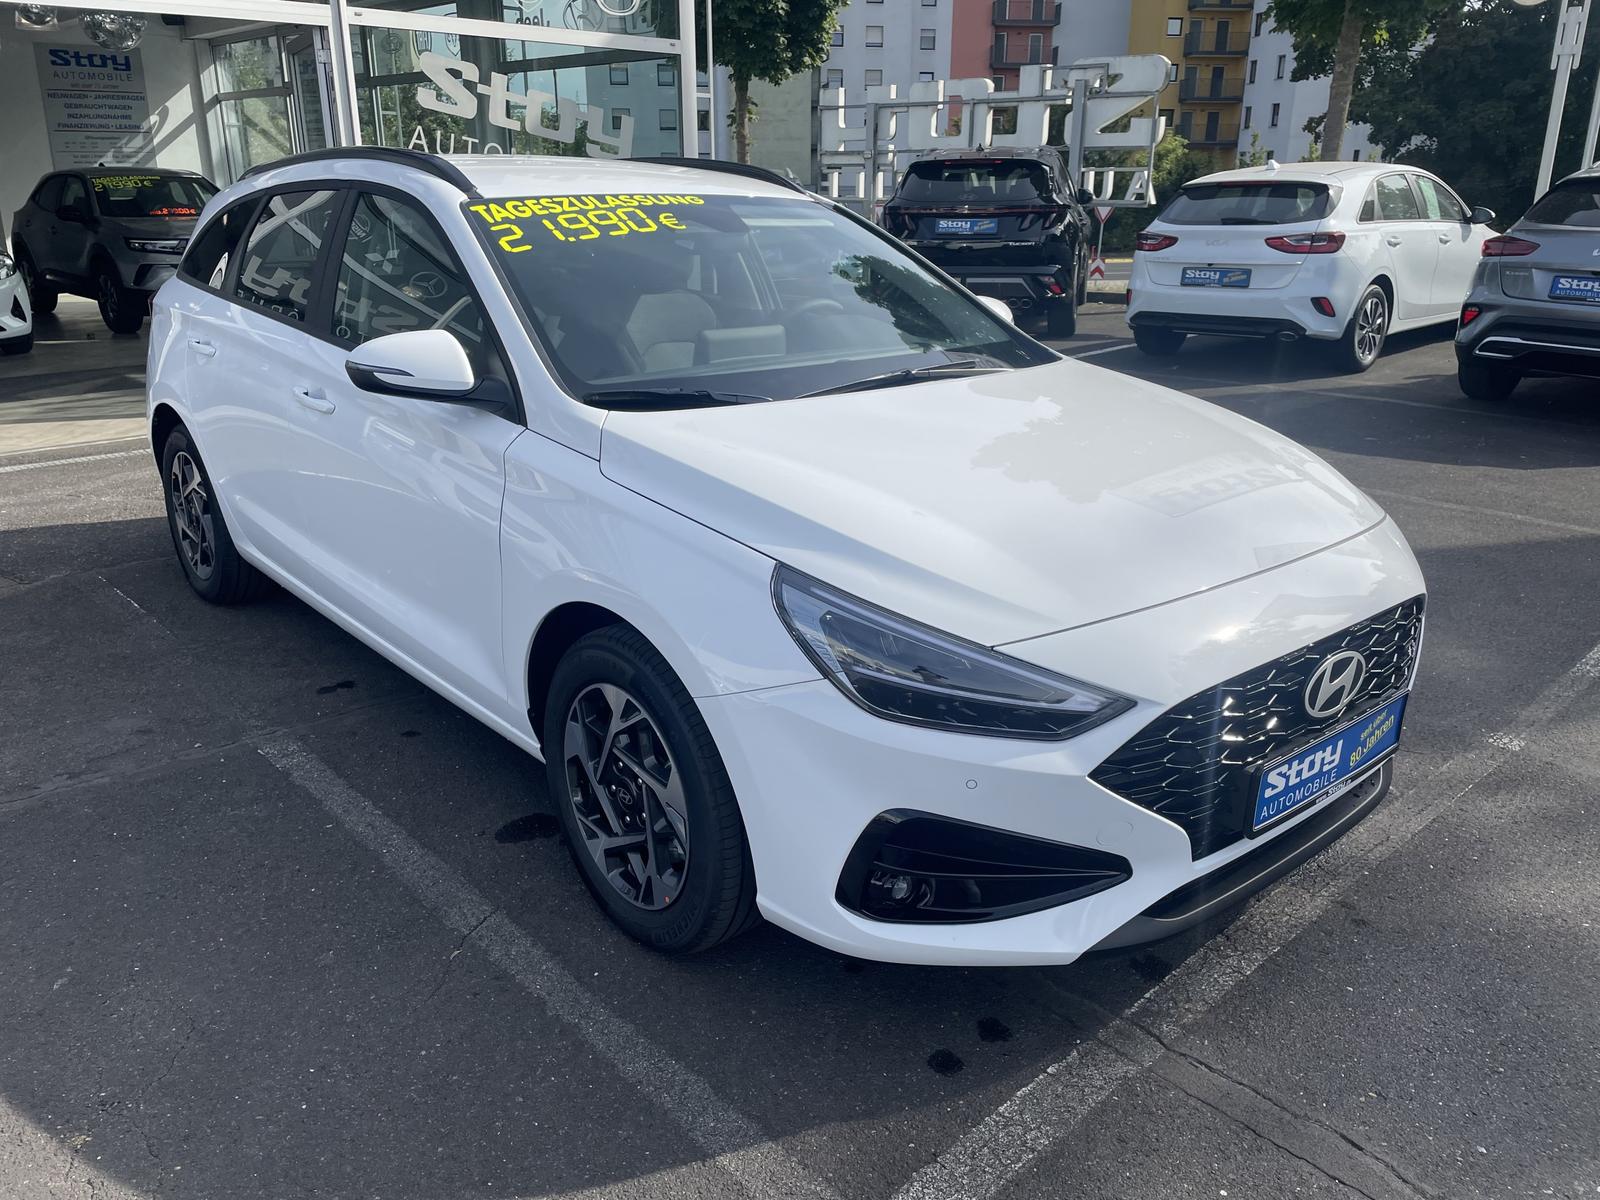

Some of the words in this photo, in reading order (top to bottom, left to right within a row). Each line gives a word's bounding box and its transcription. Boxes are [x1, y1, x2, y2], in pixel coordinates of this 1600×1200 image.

[49, 49, 131, 72] Stoy
[53, 71, 133, 82] AUTOMOBILE
[48, 92, 88, 100] NEUWAGEN
[417, 51, 635, 159] Stoy
[470, 195, 704, 223] TAGESZULASSUNG
[939, 221, 970, 229] Stoy
[1185, 270, 1220, 280] Stoy
[1349, 746, 1363, 767] 80
[1363, 714, 1395, 753] Jahren
[1264, 739, 1343, 799] Stoy
[1261, 769, 1337, 819] AUTOMOBILE
